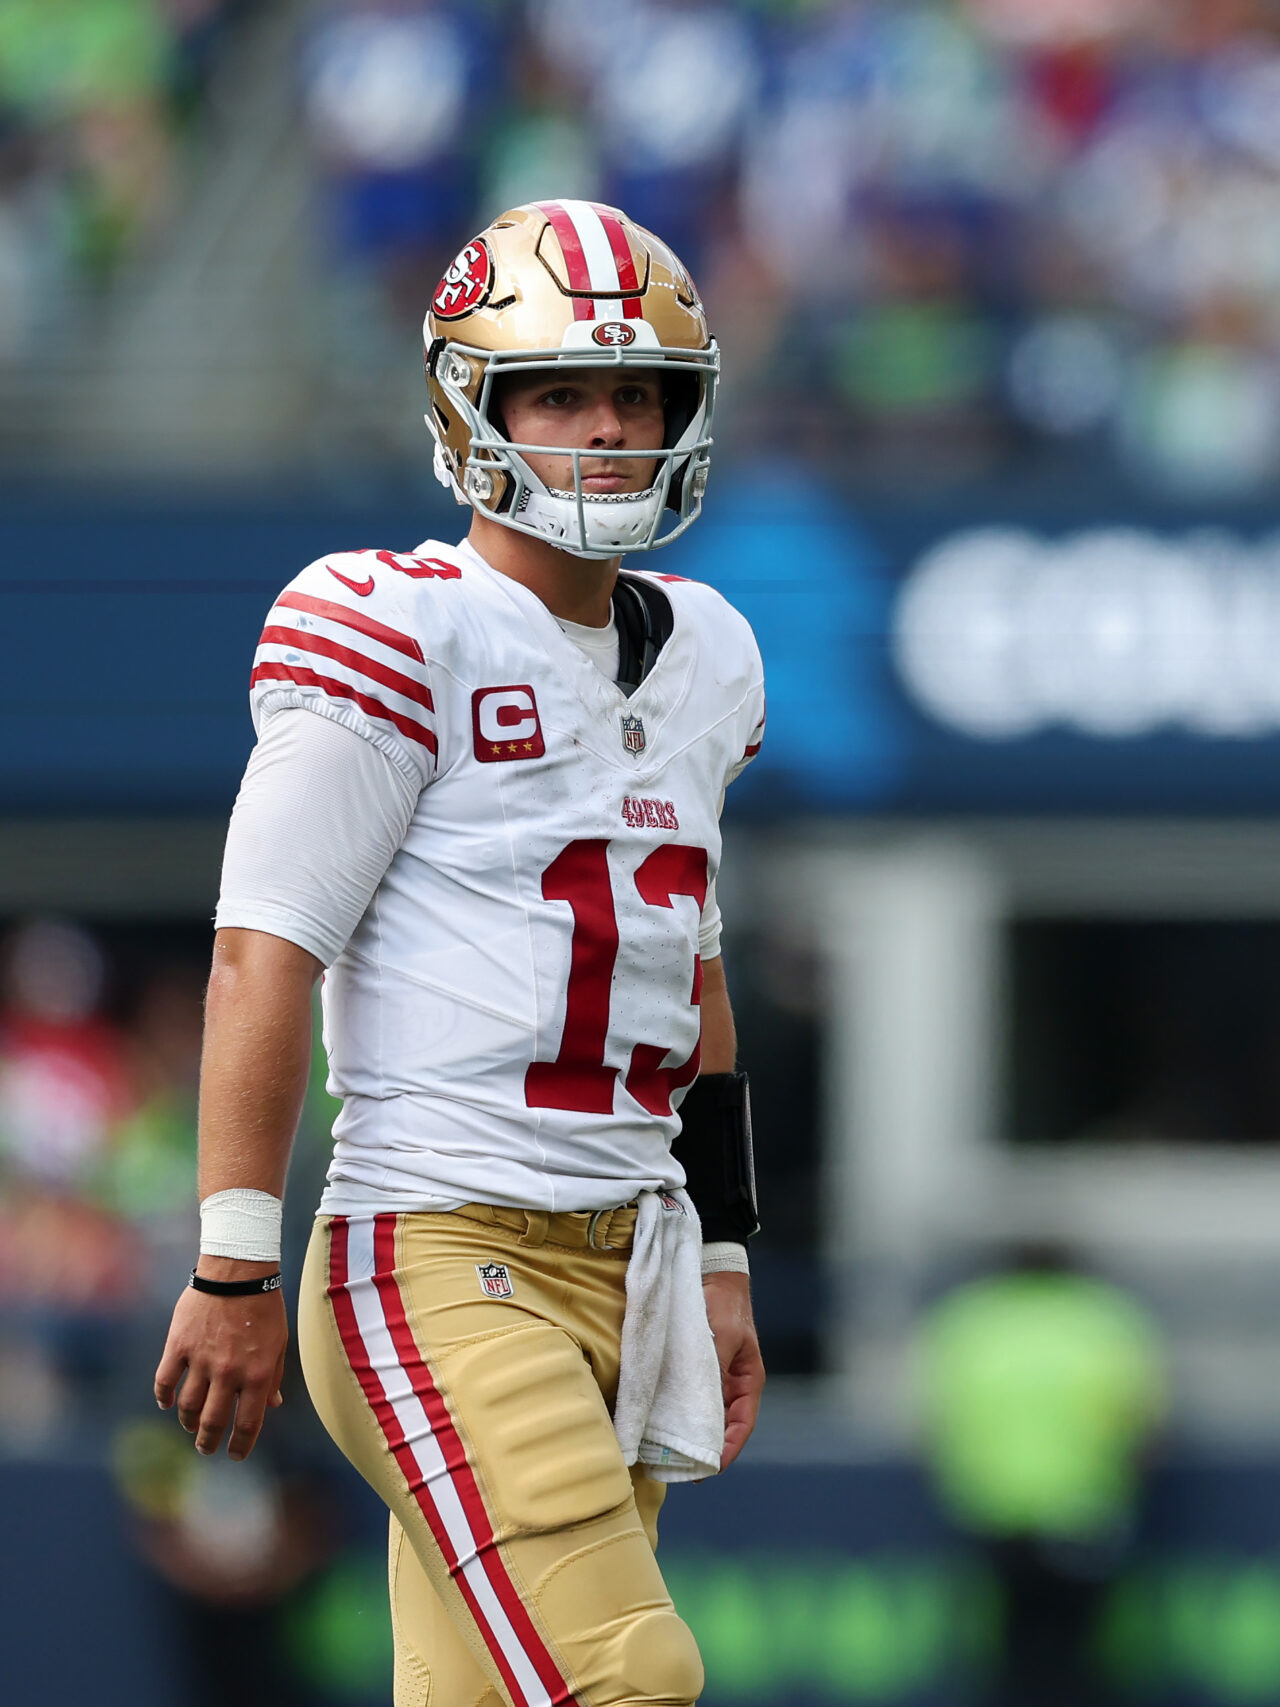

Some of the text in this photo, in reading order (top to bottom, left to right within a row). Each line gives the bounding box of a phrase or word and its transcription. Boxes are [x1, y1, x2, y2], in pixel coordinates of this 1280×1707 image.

[435, 246, 481, 310] SF
[604, 325, 629, 345] SF
[479, 691, 537, 742] C
[625, 731, 644, 750] NFL
[621, 796, 679, 830] 49ERS
[525, 839, 708, 1116] 13
[485, 1279, 509, 1294] NFL
